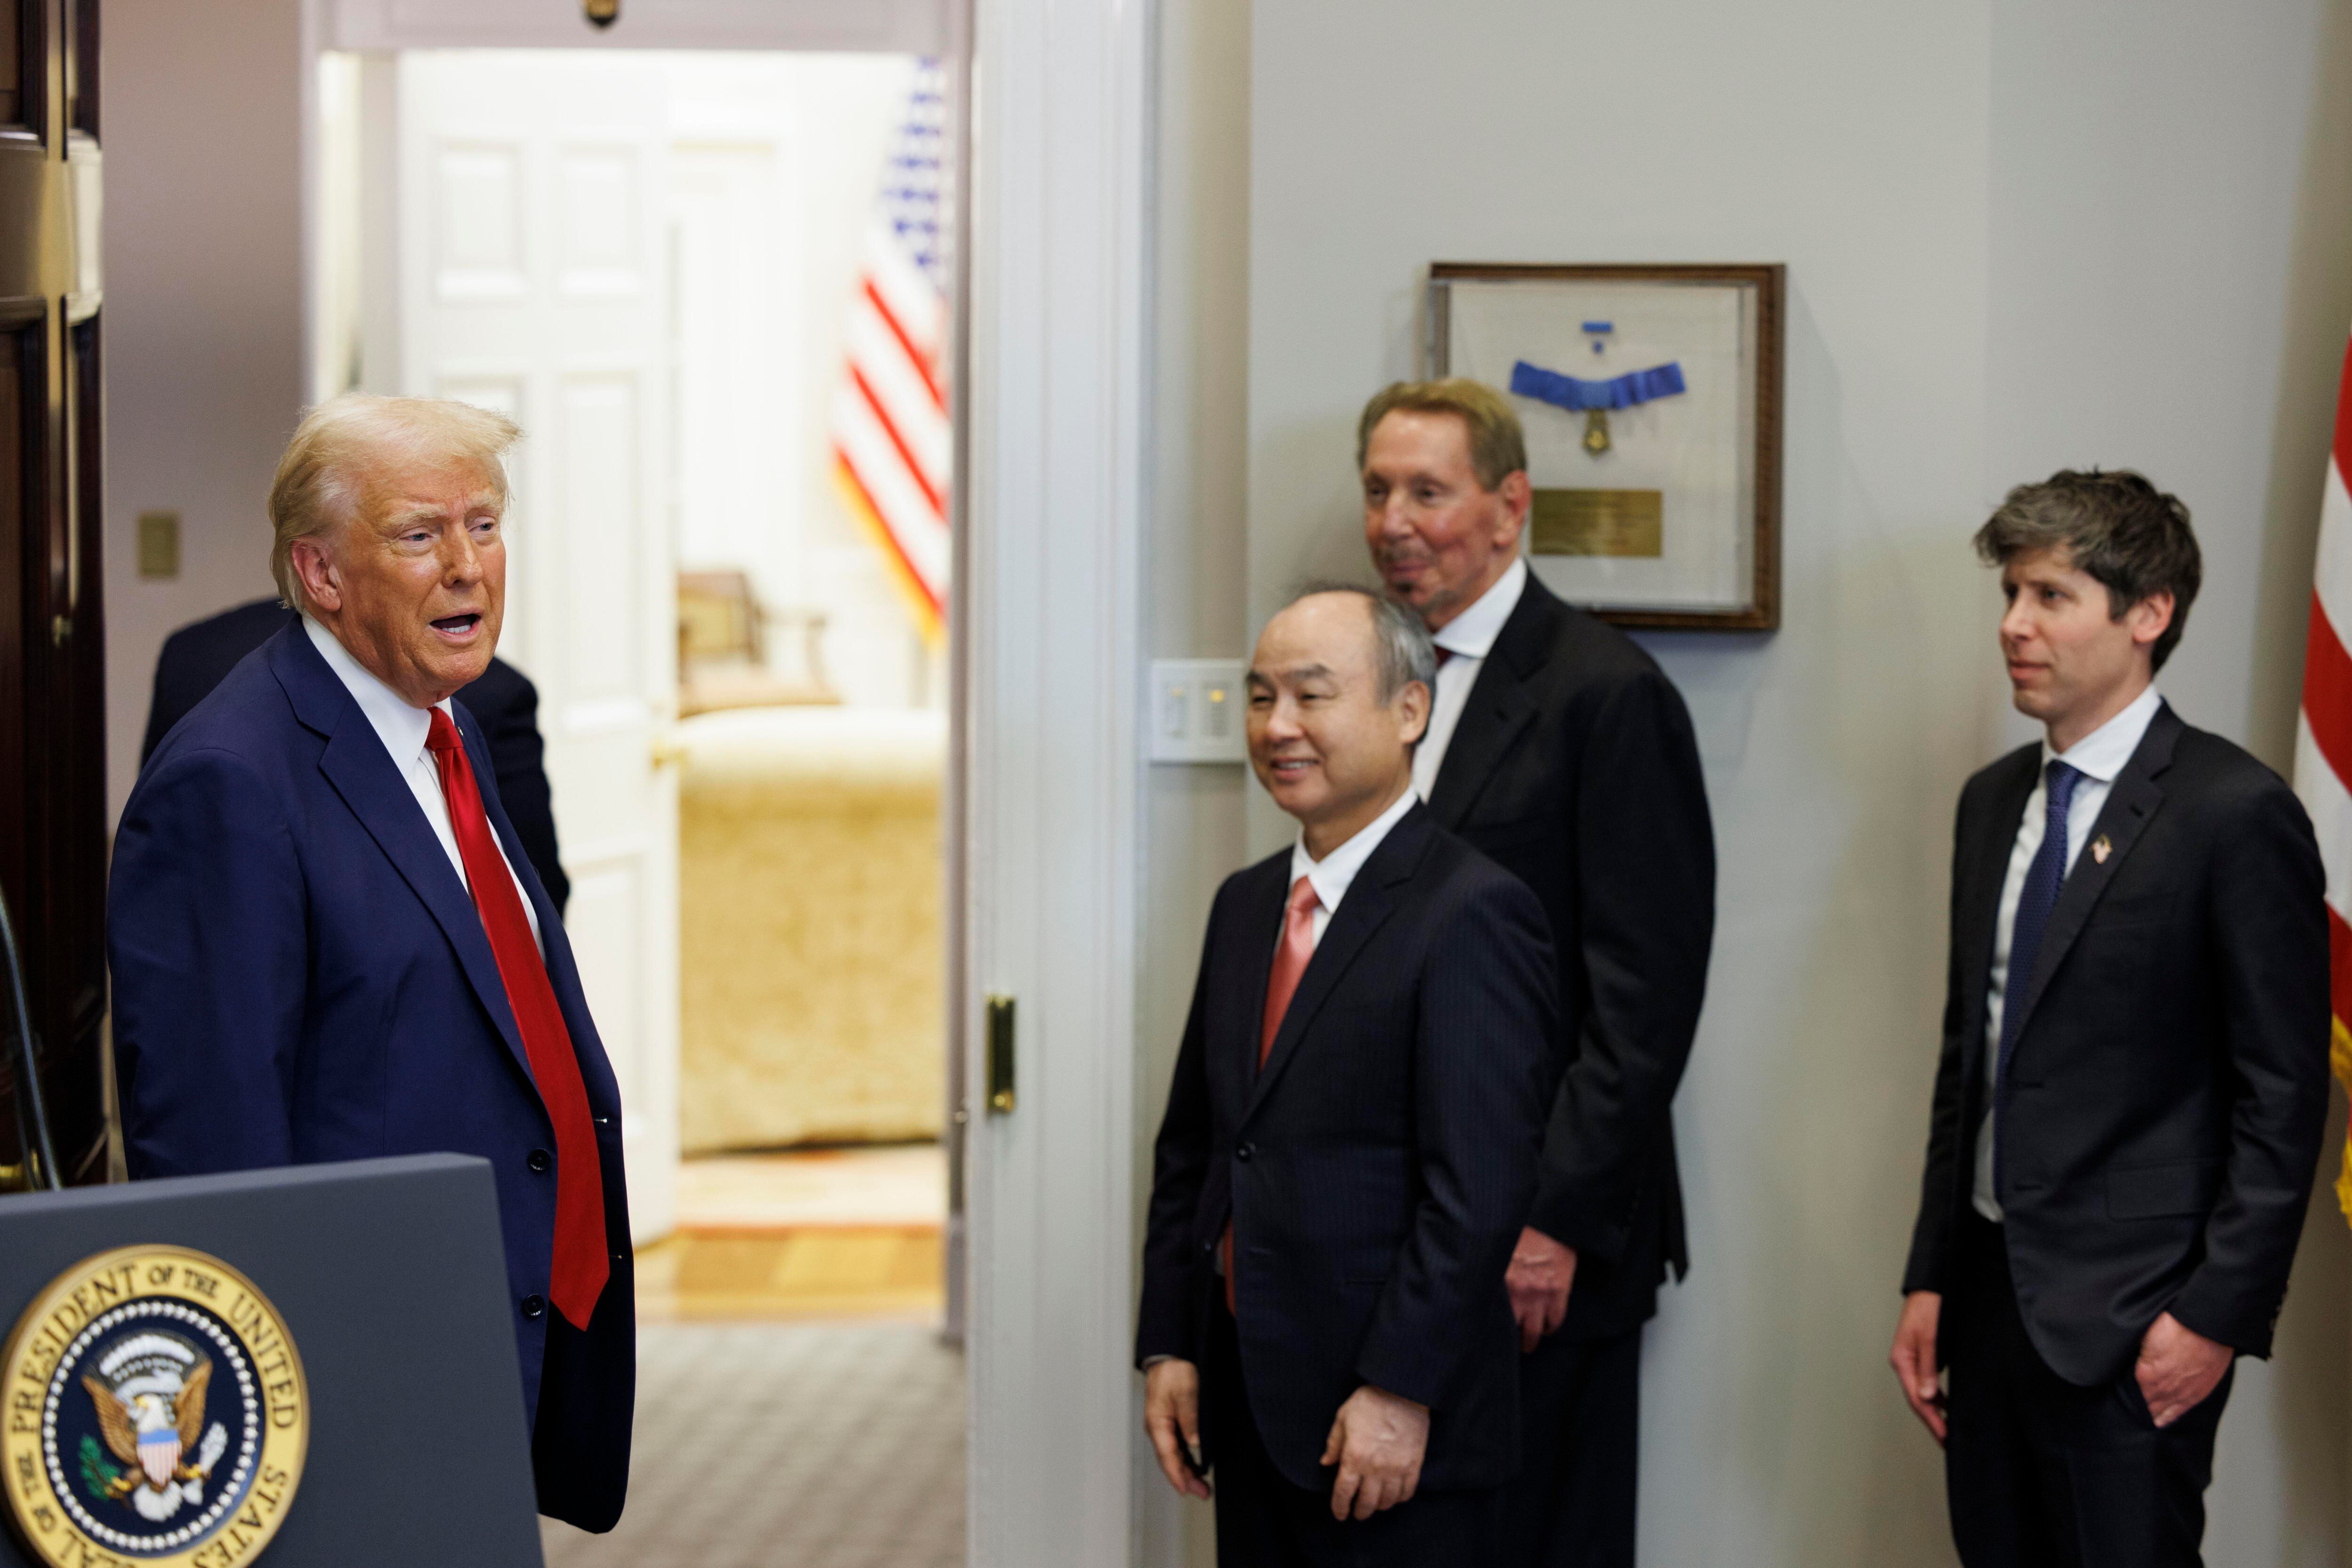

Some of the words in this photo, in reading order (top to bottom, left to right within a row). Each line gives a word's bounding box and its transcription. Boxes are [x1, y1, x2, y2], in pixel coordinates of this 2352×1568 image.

[11, 1264, 136, 1433] PRESIDENT
[147, 1264, 175, 1287] OF
[228, 1293, 297, 1429] UNITED
